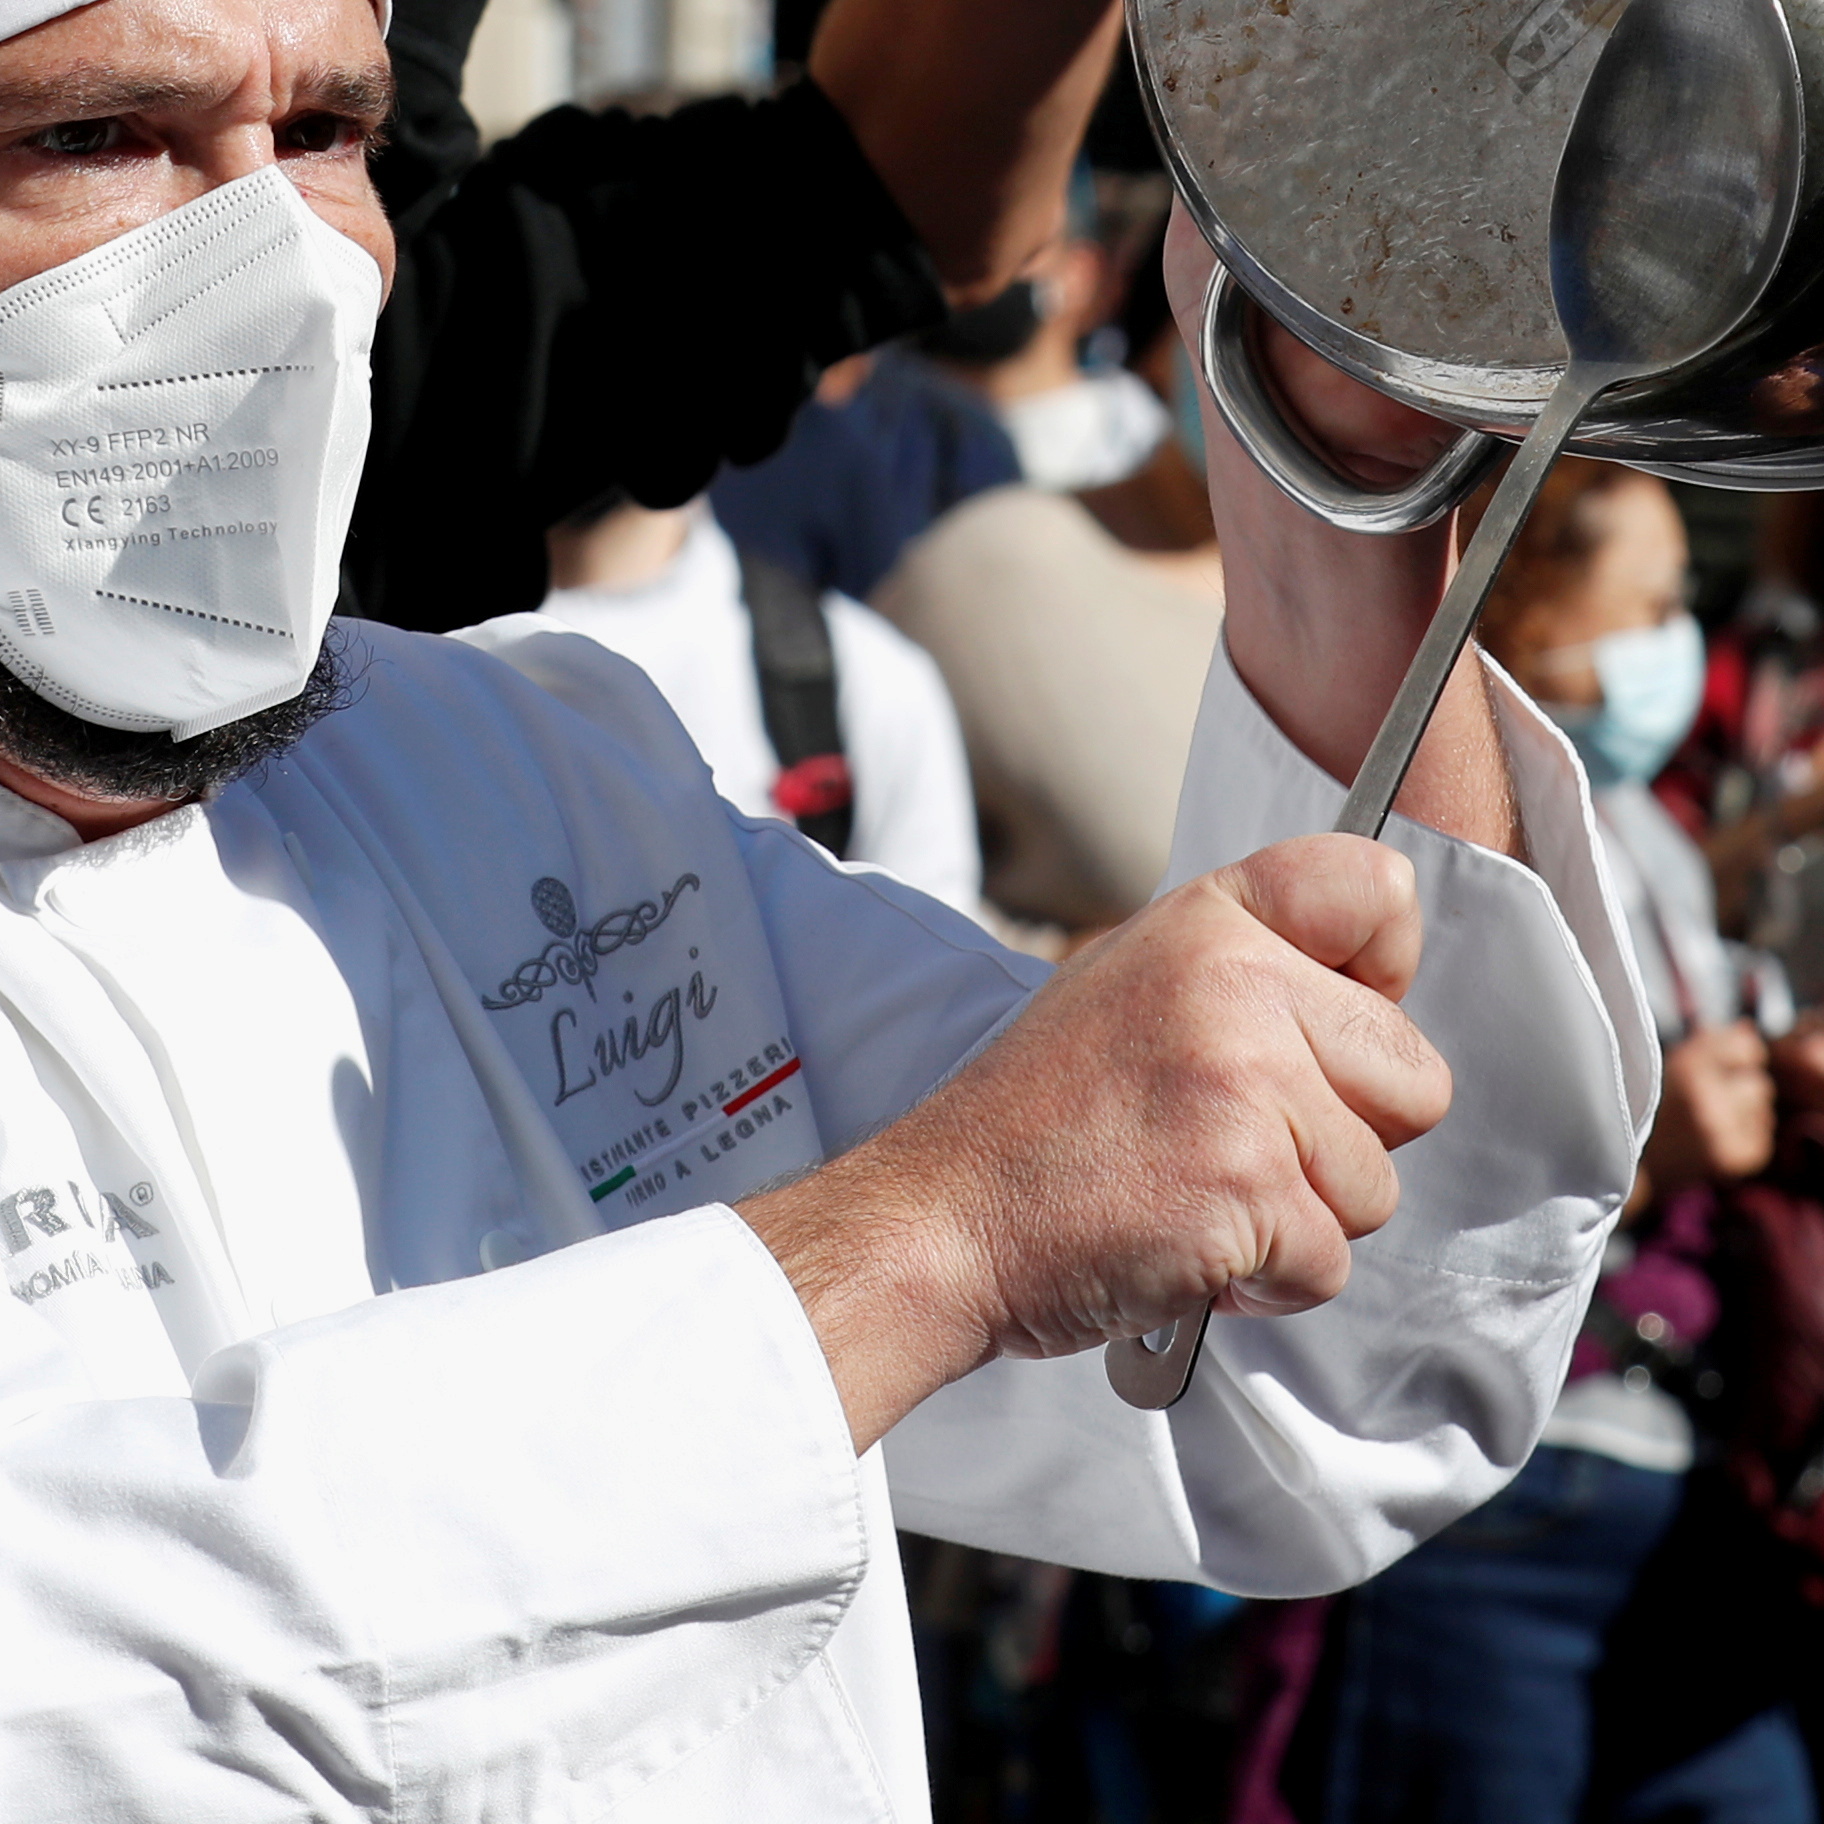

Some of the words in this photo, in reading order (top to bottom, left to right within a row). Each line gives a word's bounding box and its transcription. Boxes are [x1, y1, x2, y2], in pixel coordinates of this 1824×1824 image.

[50, 434, 101, 457] XY-9
[107, 427, 168, 451] FFP2
[175, 422, 211, 444] NR
[121, 493, 172, 517] 2163
[64, 531, 162, 553] Xiangying
[166, 520, 279, 542] Technology
[548, 945, 720, 1108] Luigi
[675, 1158, 693, 1180] A
[698, 1093, 794, 1163] LEGNA
